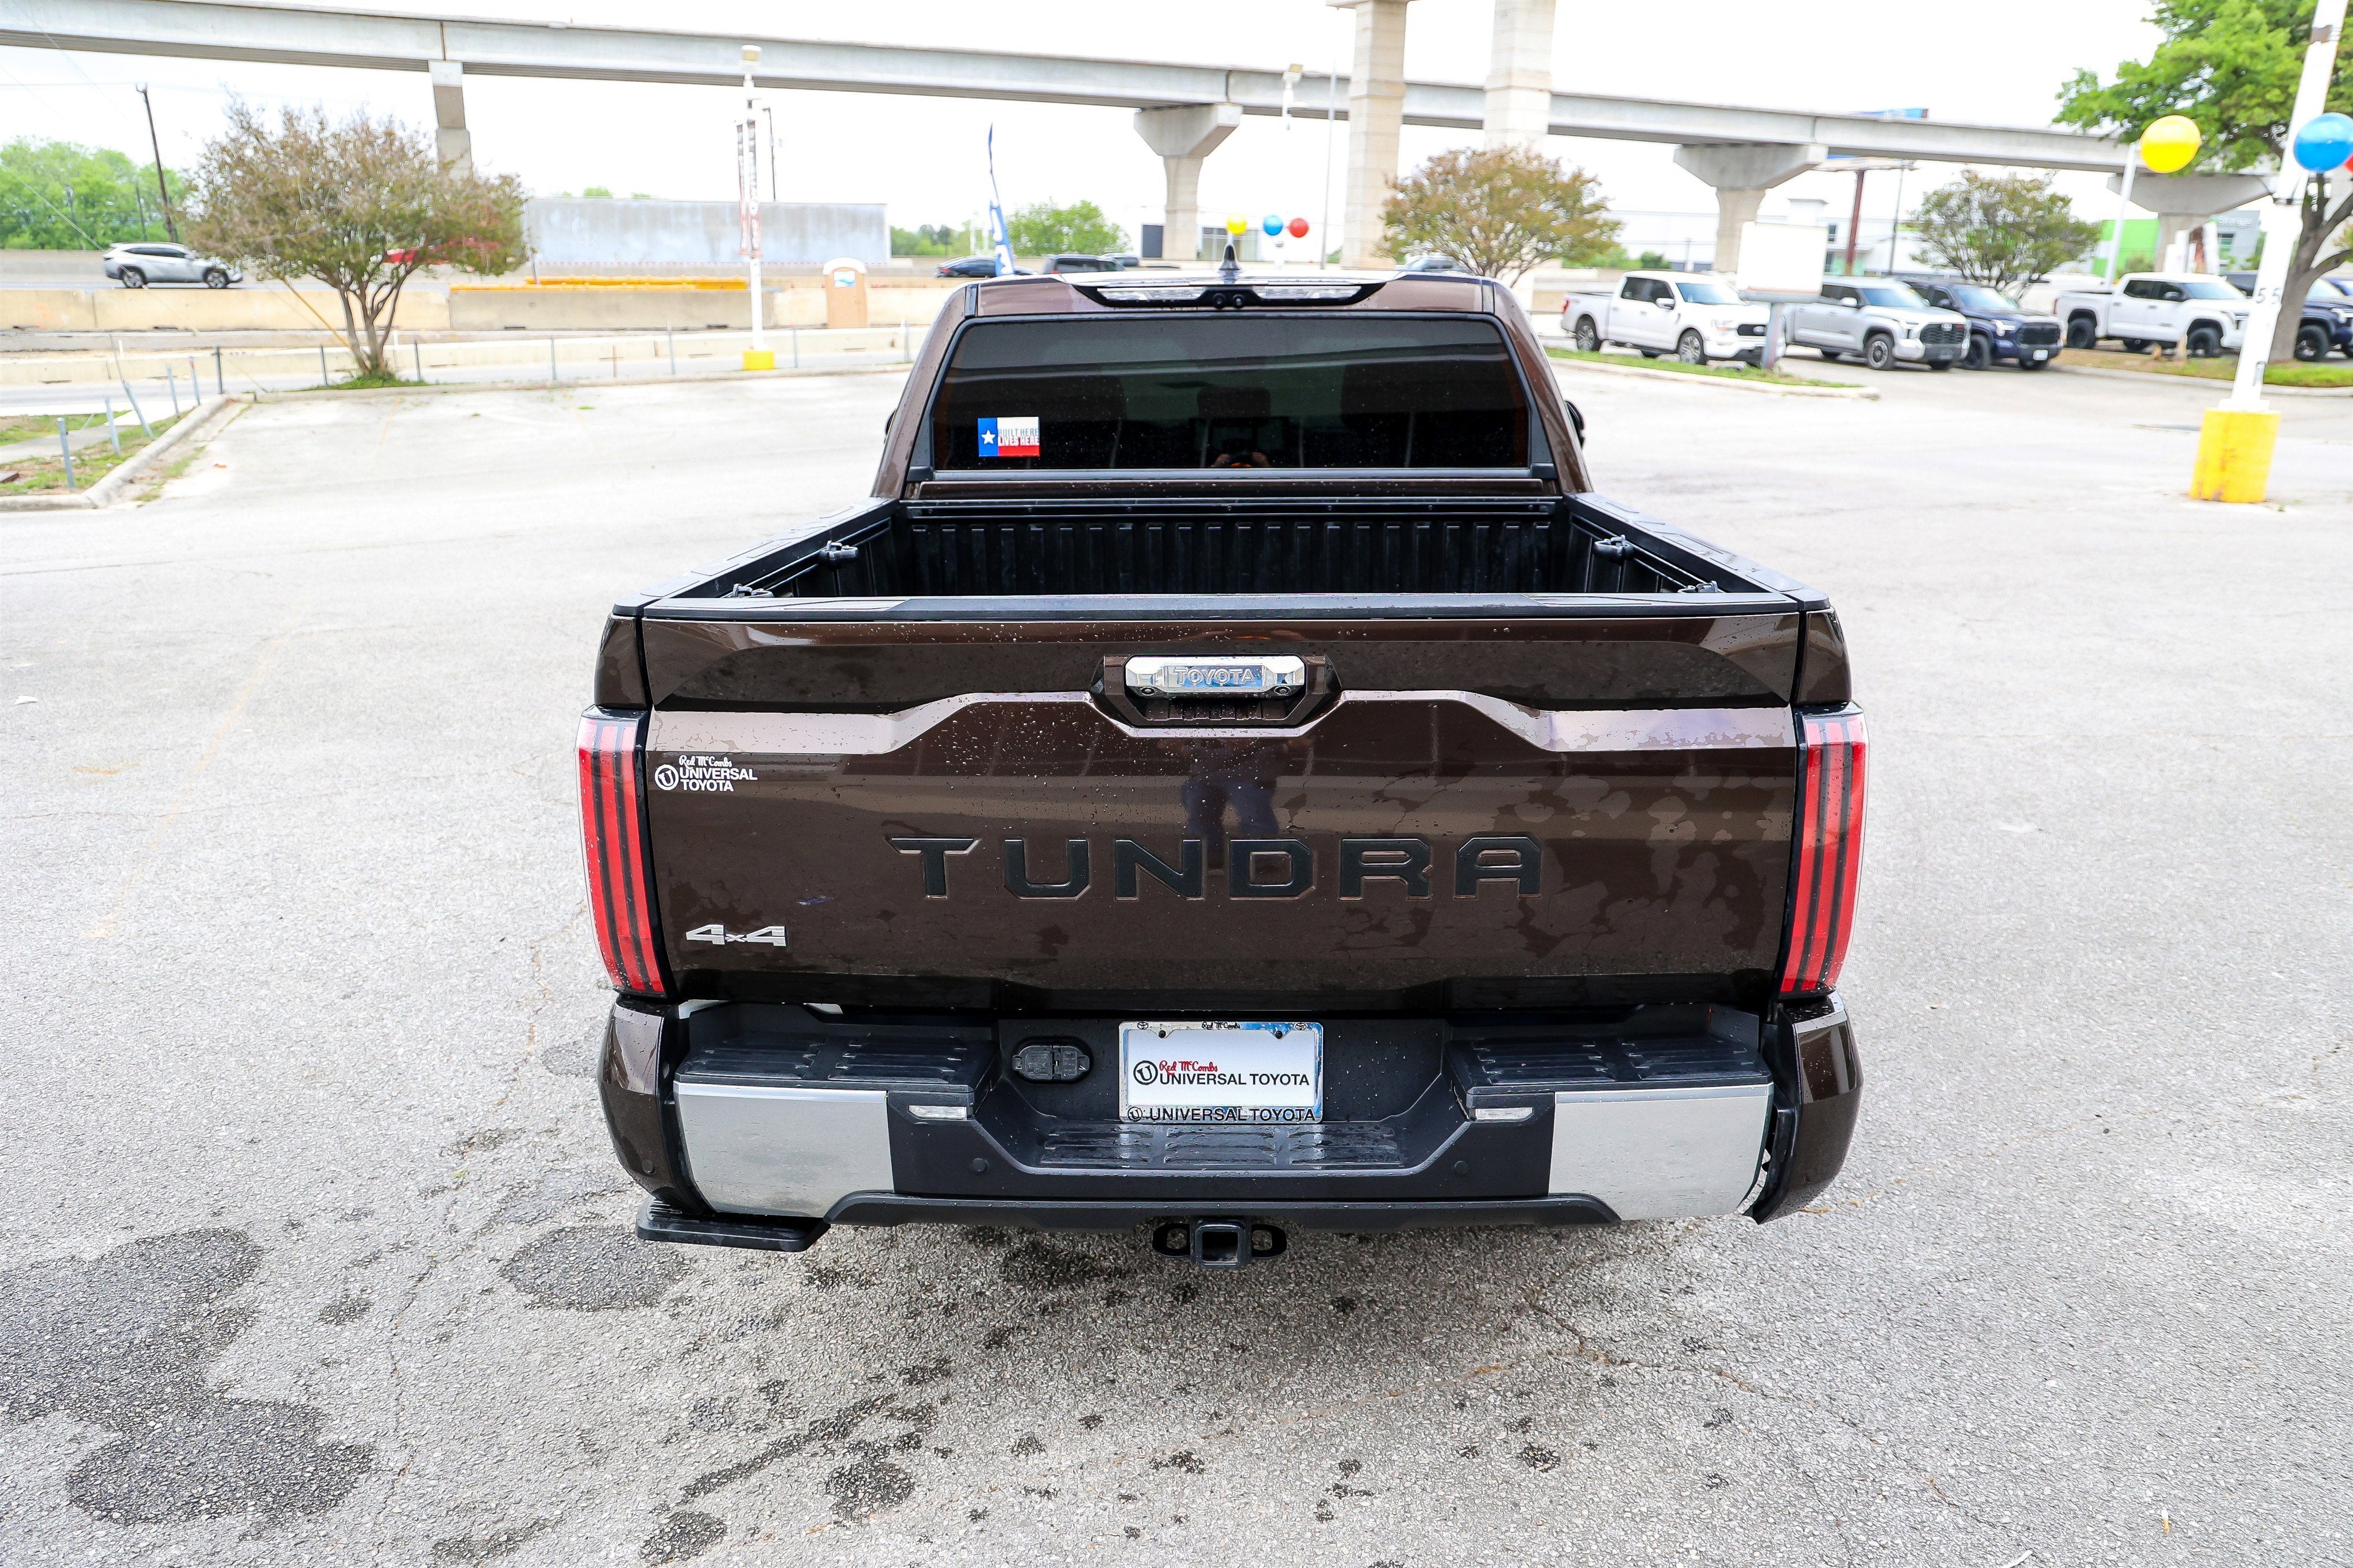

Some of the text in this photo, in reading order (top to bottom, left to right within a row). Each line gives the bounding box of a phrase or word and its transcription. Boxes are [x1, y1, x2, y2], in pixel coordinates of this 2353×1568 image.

[998, 427, 1039, 437] BUILT HERE
[998, 436, 1039, 446] LIVES HERE
[1173, 668, 1257, 685] TOYOTA
[678, 755, 732, 770] Red McCombs
[679, 767, 758, 781] UNIVERSAL
[680, 779, 735, 792] TOYOTA
[885, 836, 1543, 902] TUNDRA
[1201, 1021, 1213, 1030] Red
[1159, 1060, 1218, 1075] Red McCombs
[1159, 1072, 1310, 1086] UNIVERSAL TOYOTA
[1149, 1107, 1316, 1122] UNIVERSAL TOYOTA
